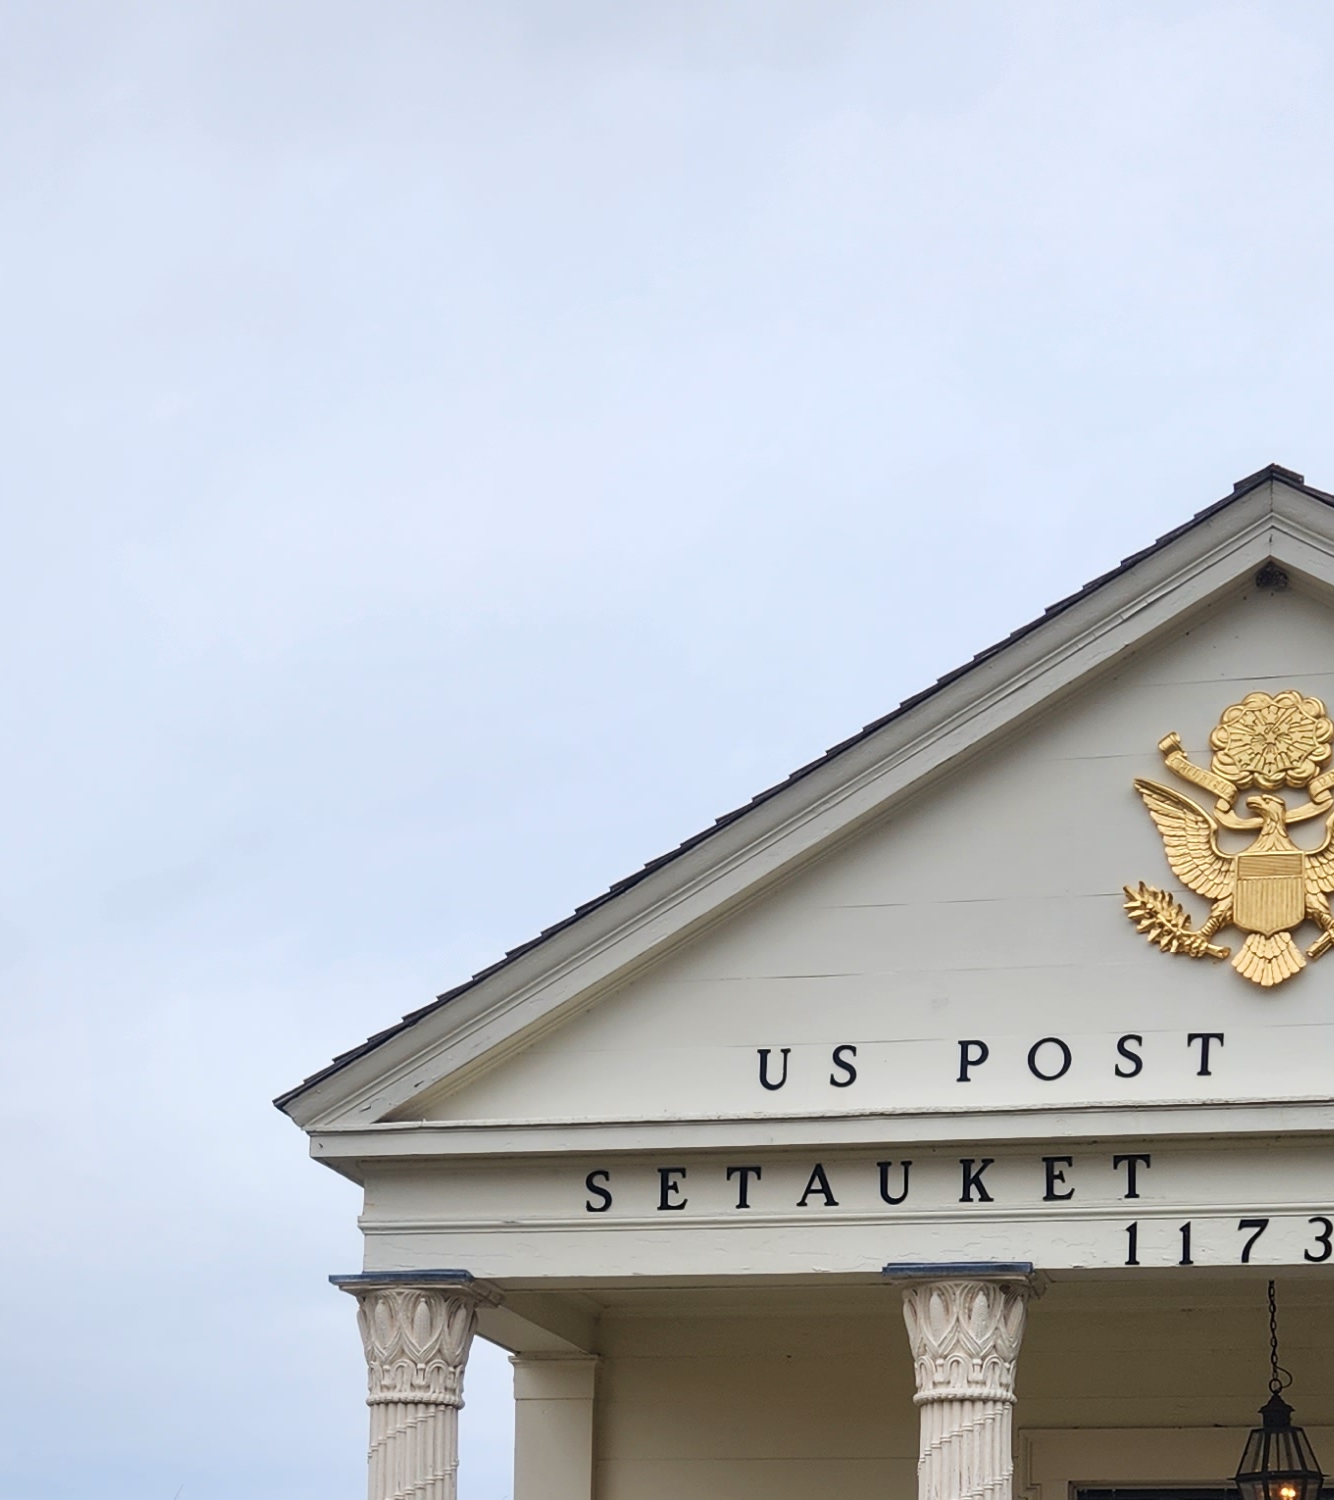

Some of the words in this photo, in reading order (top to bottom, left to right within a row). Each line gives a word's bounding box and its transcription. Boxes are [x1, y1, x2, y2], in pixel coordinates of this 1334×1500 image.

[755, 1043, 858, 1092] US
[955, 1031, 1226, 1084] POST
[584, 1153, 1151, 1213] SETAUKET
